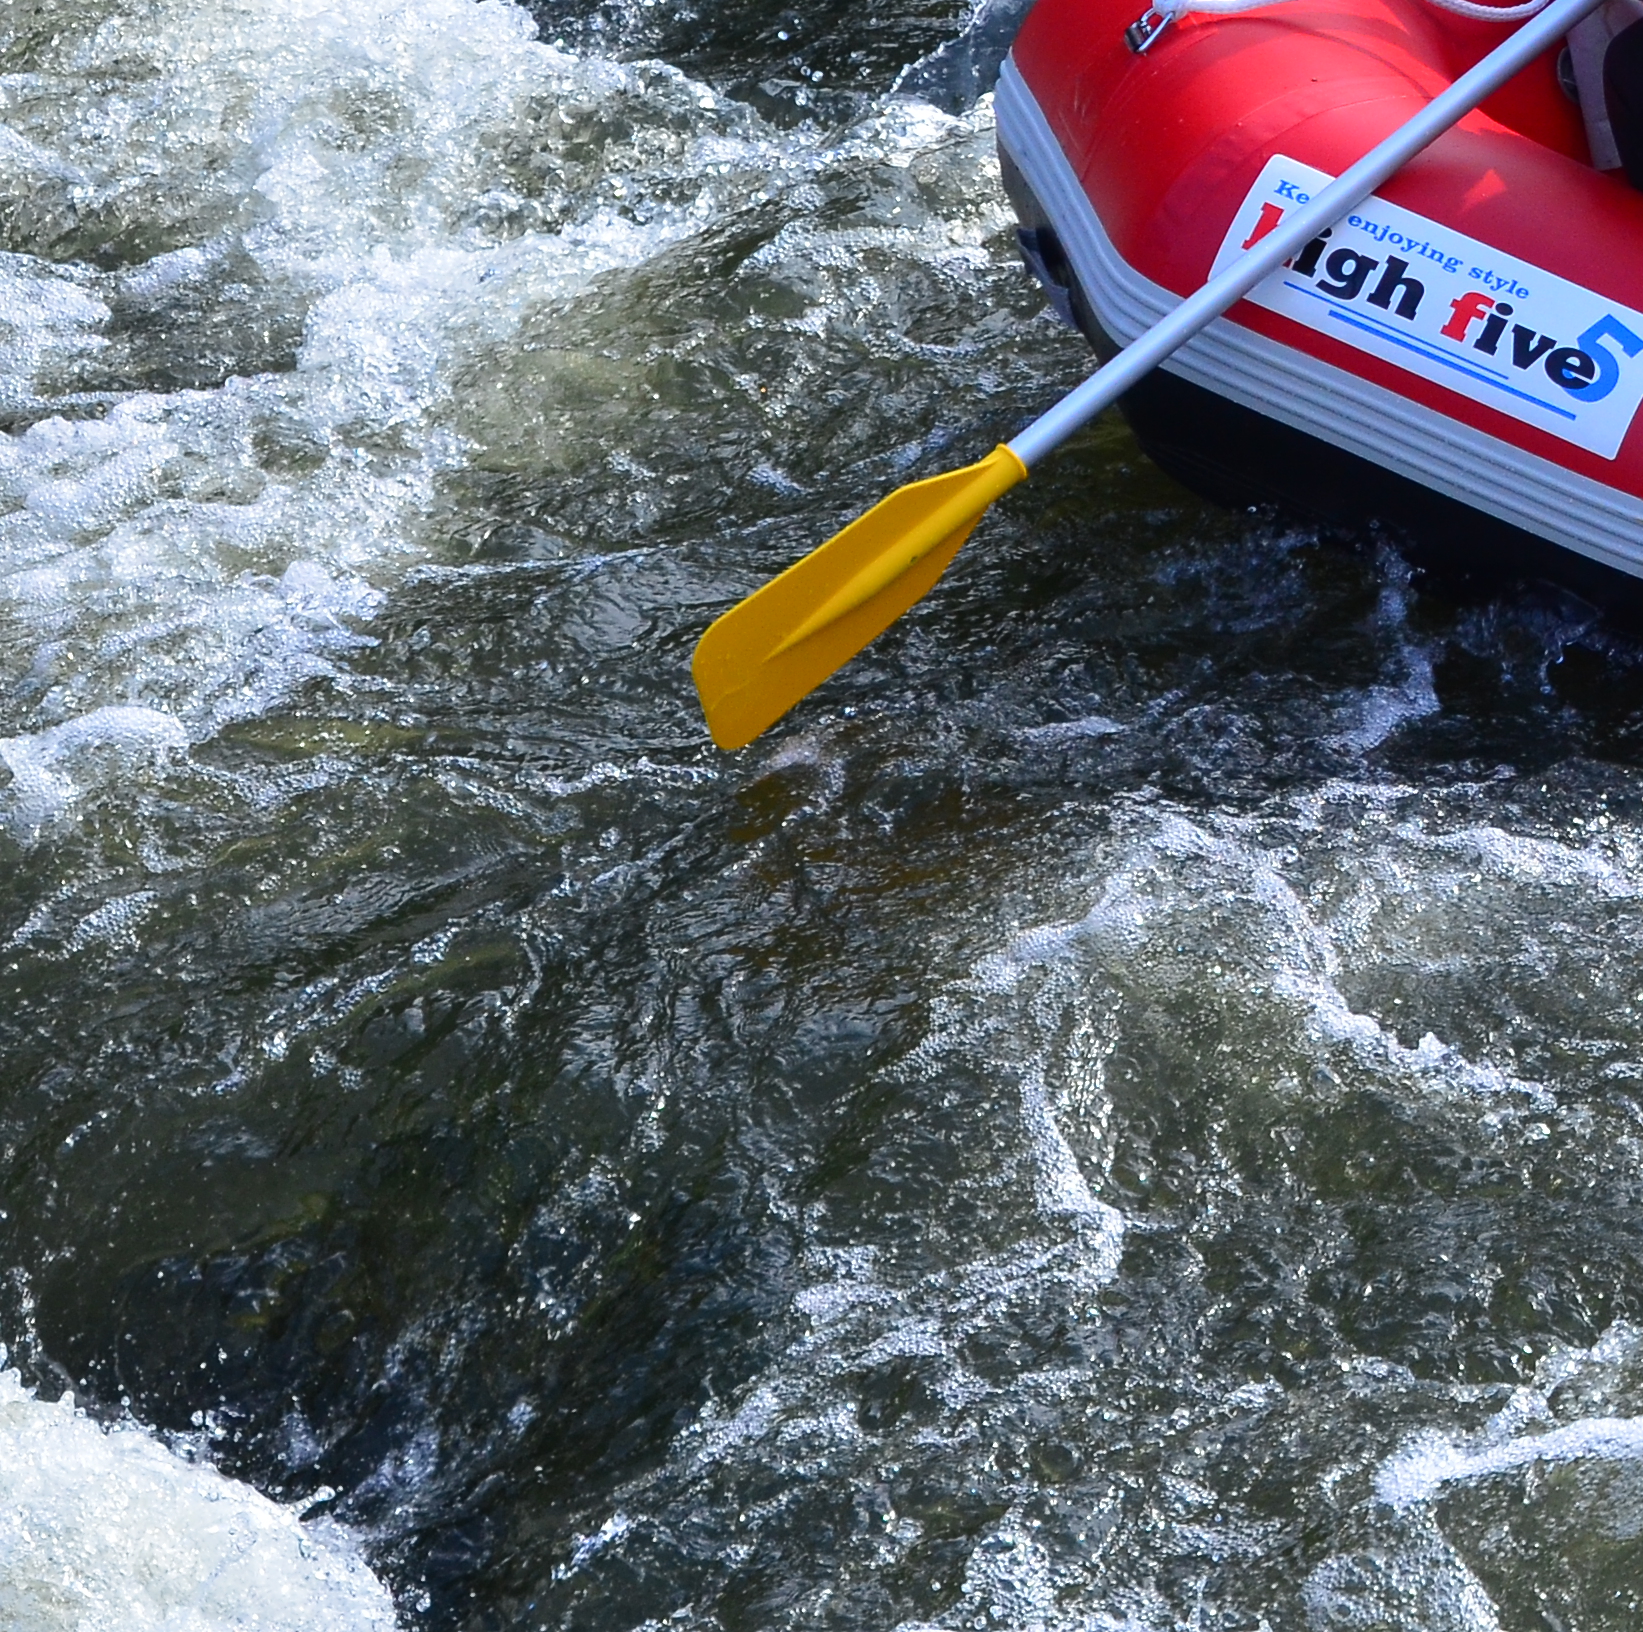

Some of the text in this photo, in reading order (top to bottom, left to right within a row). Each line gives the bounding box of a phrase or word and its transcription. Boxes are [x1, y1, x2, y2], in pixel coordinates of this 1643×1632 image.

[1273, 179, 1530, 299] Ke enjoying style
[1440, 291, 1596, 389] five
